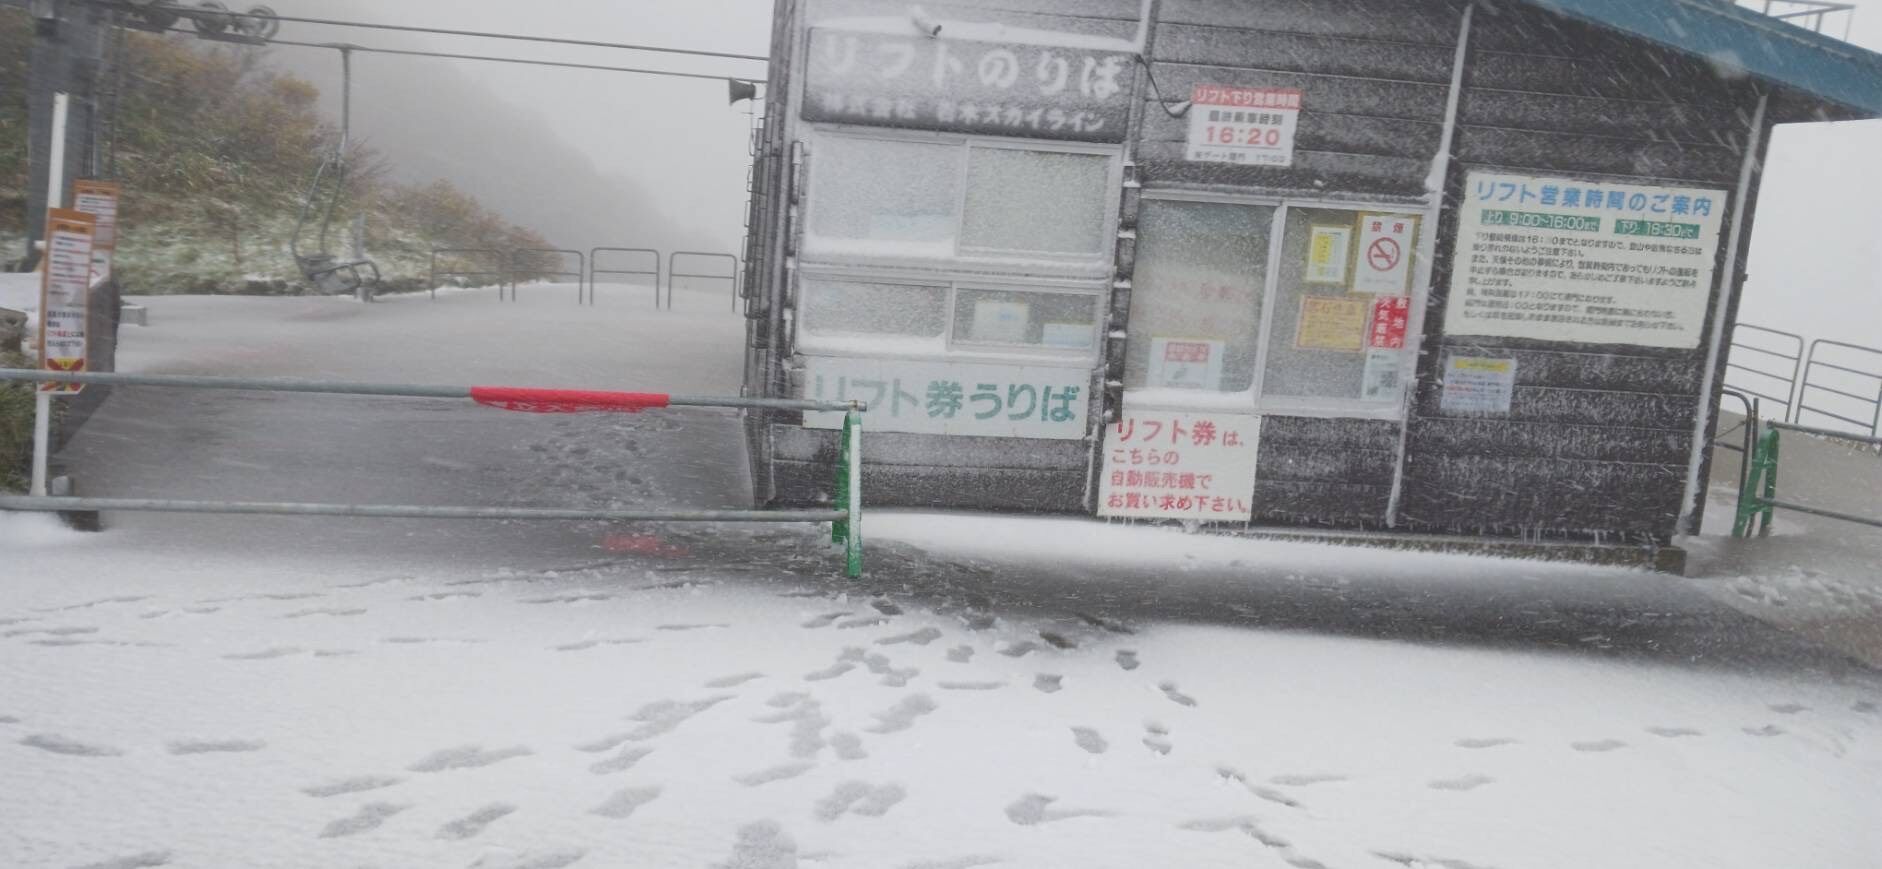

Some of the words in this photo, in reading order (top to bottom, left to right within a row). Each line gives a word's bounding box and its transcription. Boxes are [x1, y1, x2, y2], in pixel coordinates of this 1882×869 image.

[825, 34, 1124, 101] リフトのりば
[1207, 126, 1280, 146] 16:20
[1477, 180, 1713, 217] リフト営業時間のご案内
[816, 374, 1080, 423] リフト券うりば
[1112, 449, 1179, 465] こちらの
[1111, 470, 1213, 489] 自動販売機で
[1107, 491, 1248, 514] お買い求め下さい。
